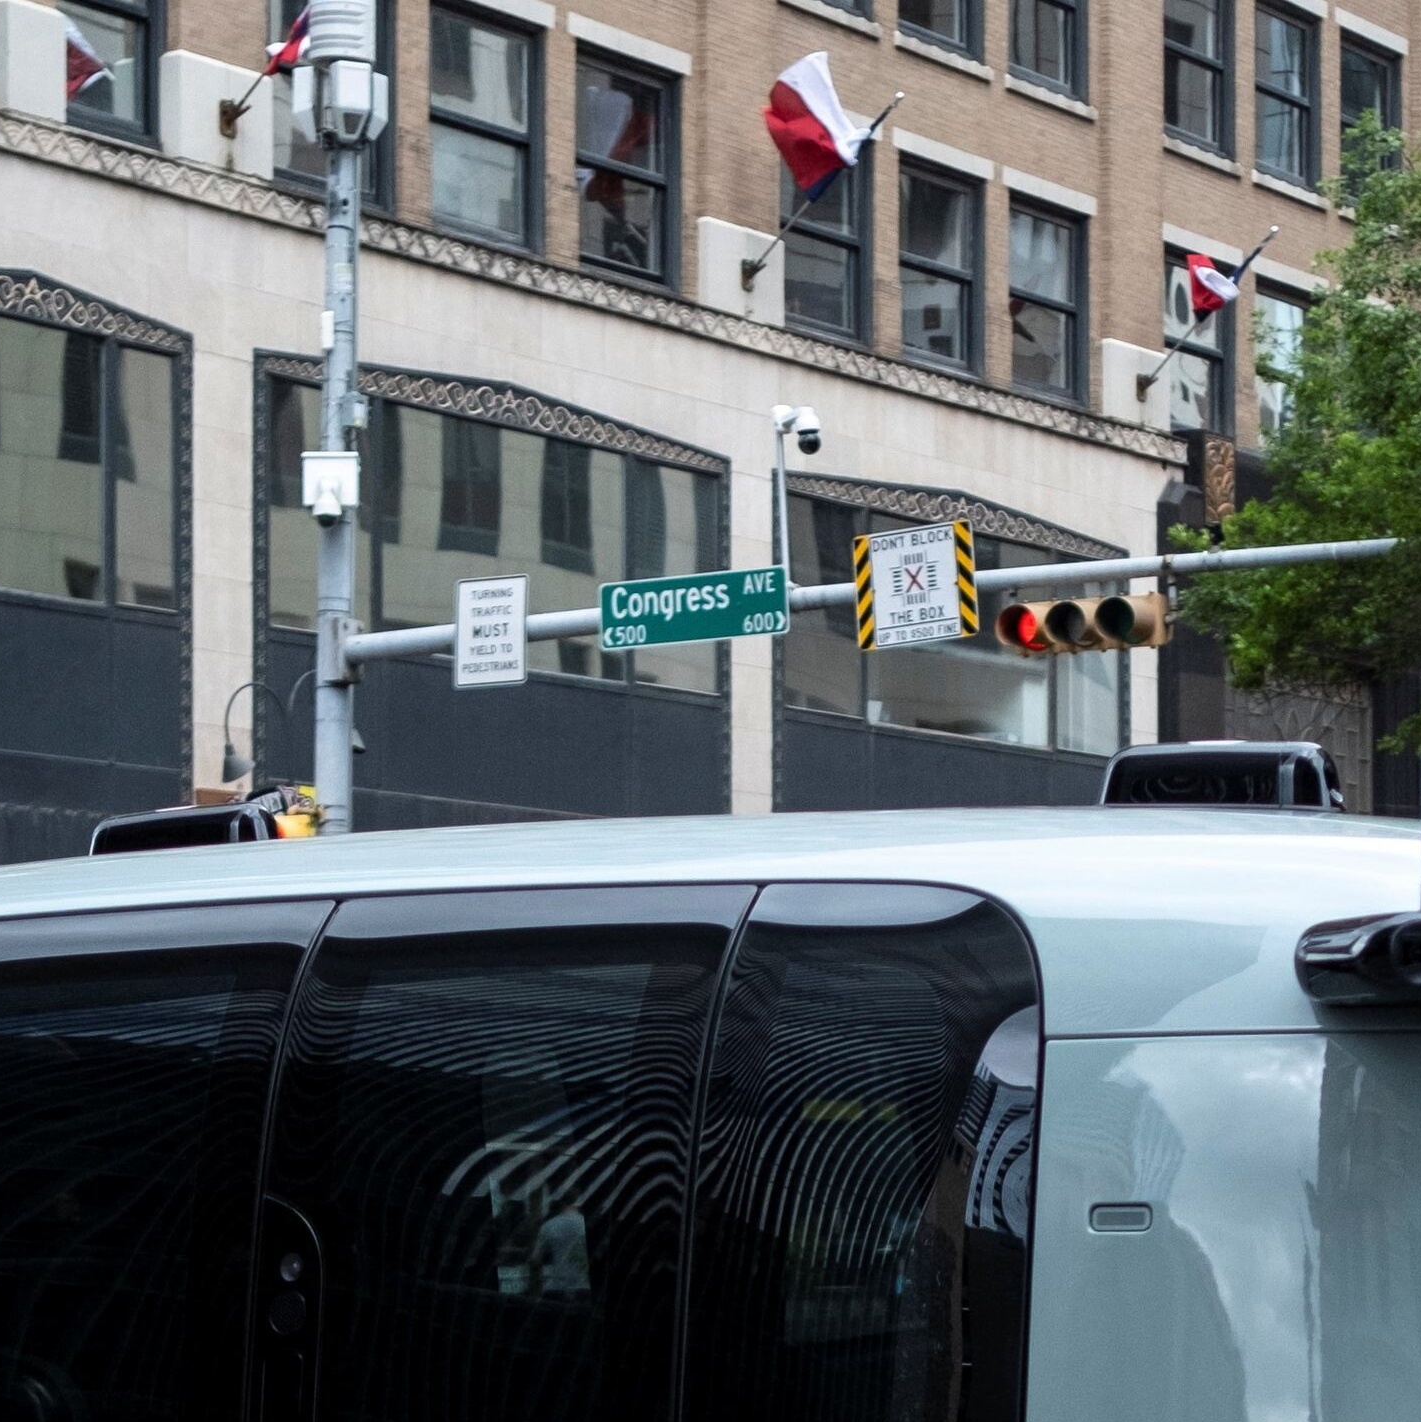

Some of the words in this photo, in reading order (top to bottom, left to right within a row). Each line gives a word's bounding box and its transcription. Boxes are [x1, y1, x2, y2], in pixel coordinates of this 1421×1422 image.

[873, 536, 905, 552] DON'T
[910, 529, 953, 547] BLOCK
[471, 587, 514, 600] TURNING
[611, 583, 730, 621] Congress
[743, 571, 776, 595] AVE
[471, 605, 512, 617] TRAFFIC
[890, 610, 914, 624] THE
[919, 605, 946, 620] BOX
[472, 622, 510, 639] MUST
[615, 624, 647, 645] 500
[743, 612, 774, 633] 600
[879, 631, 891, 644] UP
[896, 629, 908, 641] TO
[911, 626, 935, 639] $500
[938, 622, 958, 636] FINE
[469, 644, 497, 656] YIELD
[500, 643, 513, 654] TO
[462, 660, 519, 673] PEDESTRIANS
